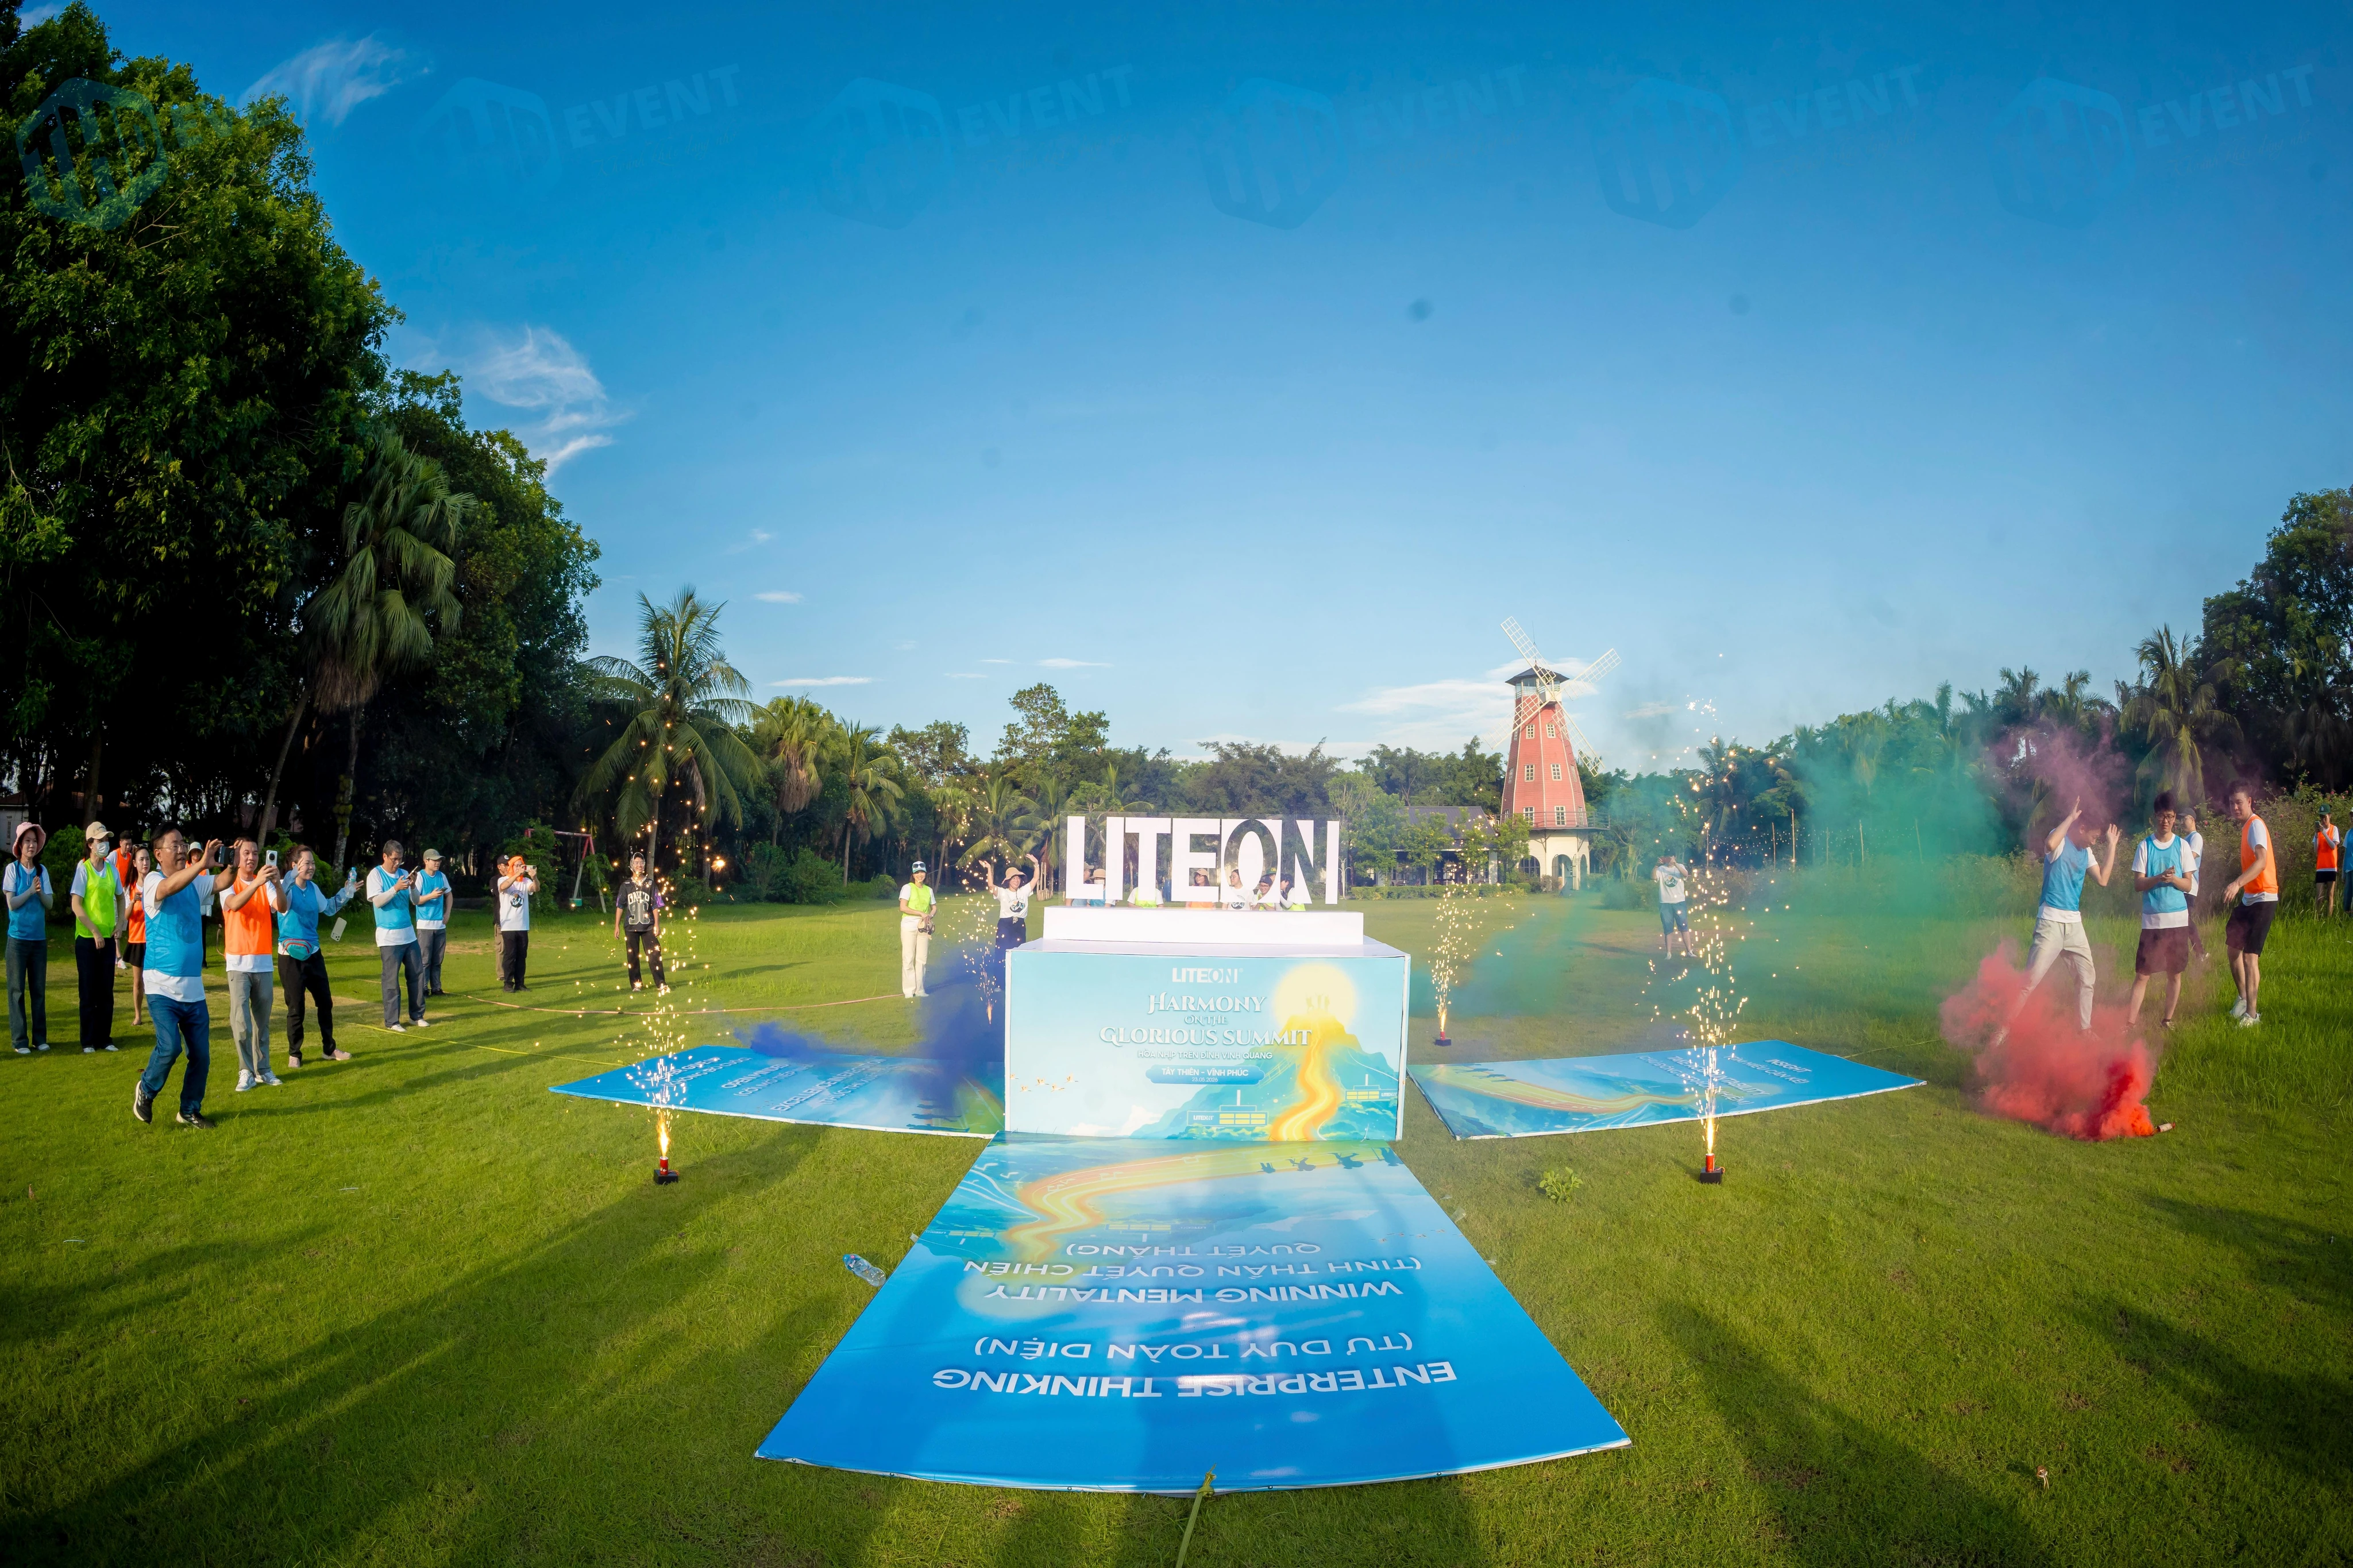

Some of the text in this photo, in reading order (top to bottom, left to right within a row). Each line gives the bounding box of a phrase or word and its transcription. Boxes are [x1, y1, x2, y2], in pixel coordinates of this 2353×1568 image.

[1066, 816, 1340, 904] LITEON
[1172, 967, 1238, 983] LITEON
[1147, 992, 1266, 1014] HARMONY
[1185, 1014, 1228, 1026] ON THE
[1100, 1027, 1311, 1046] GLORIOUS SUMMIT
[1158, 1052, 1176, 1060] NHỊP
[1178, 1050, 1198, 1059] TRÊN
[1162, 1067, 1175, 1075] TÂY
[1178, 1067, 1199, 1076] THIÊN
[1207, 1068, 1225, 1076] VĨNH
[1227, 1067, 1249, 1076] PHÚC
[1763, 1059, 1812, 1072] INSIGHT
[722, 1076, 754, 1088] OPEN
[770, 1080, 836, 1111] EXCELLENCE
[1066, 1242, 1321, 1260] QUYẾT THẮNG)
[1082, 1265, 1205, 1280] QUYẾT
[1217, 1264, 1318, 1280] THẦN
[983, 1281, 1403, 1303] WINNING MENTALITY
[974, 1333, 1413, 1363] (TƯ DUY TOÀN DIỆN)
[932, 1361, 1457, 1397] ENTERPRISE THINKING
